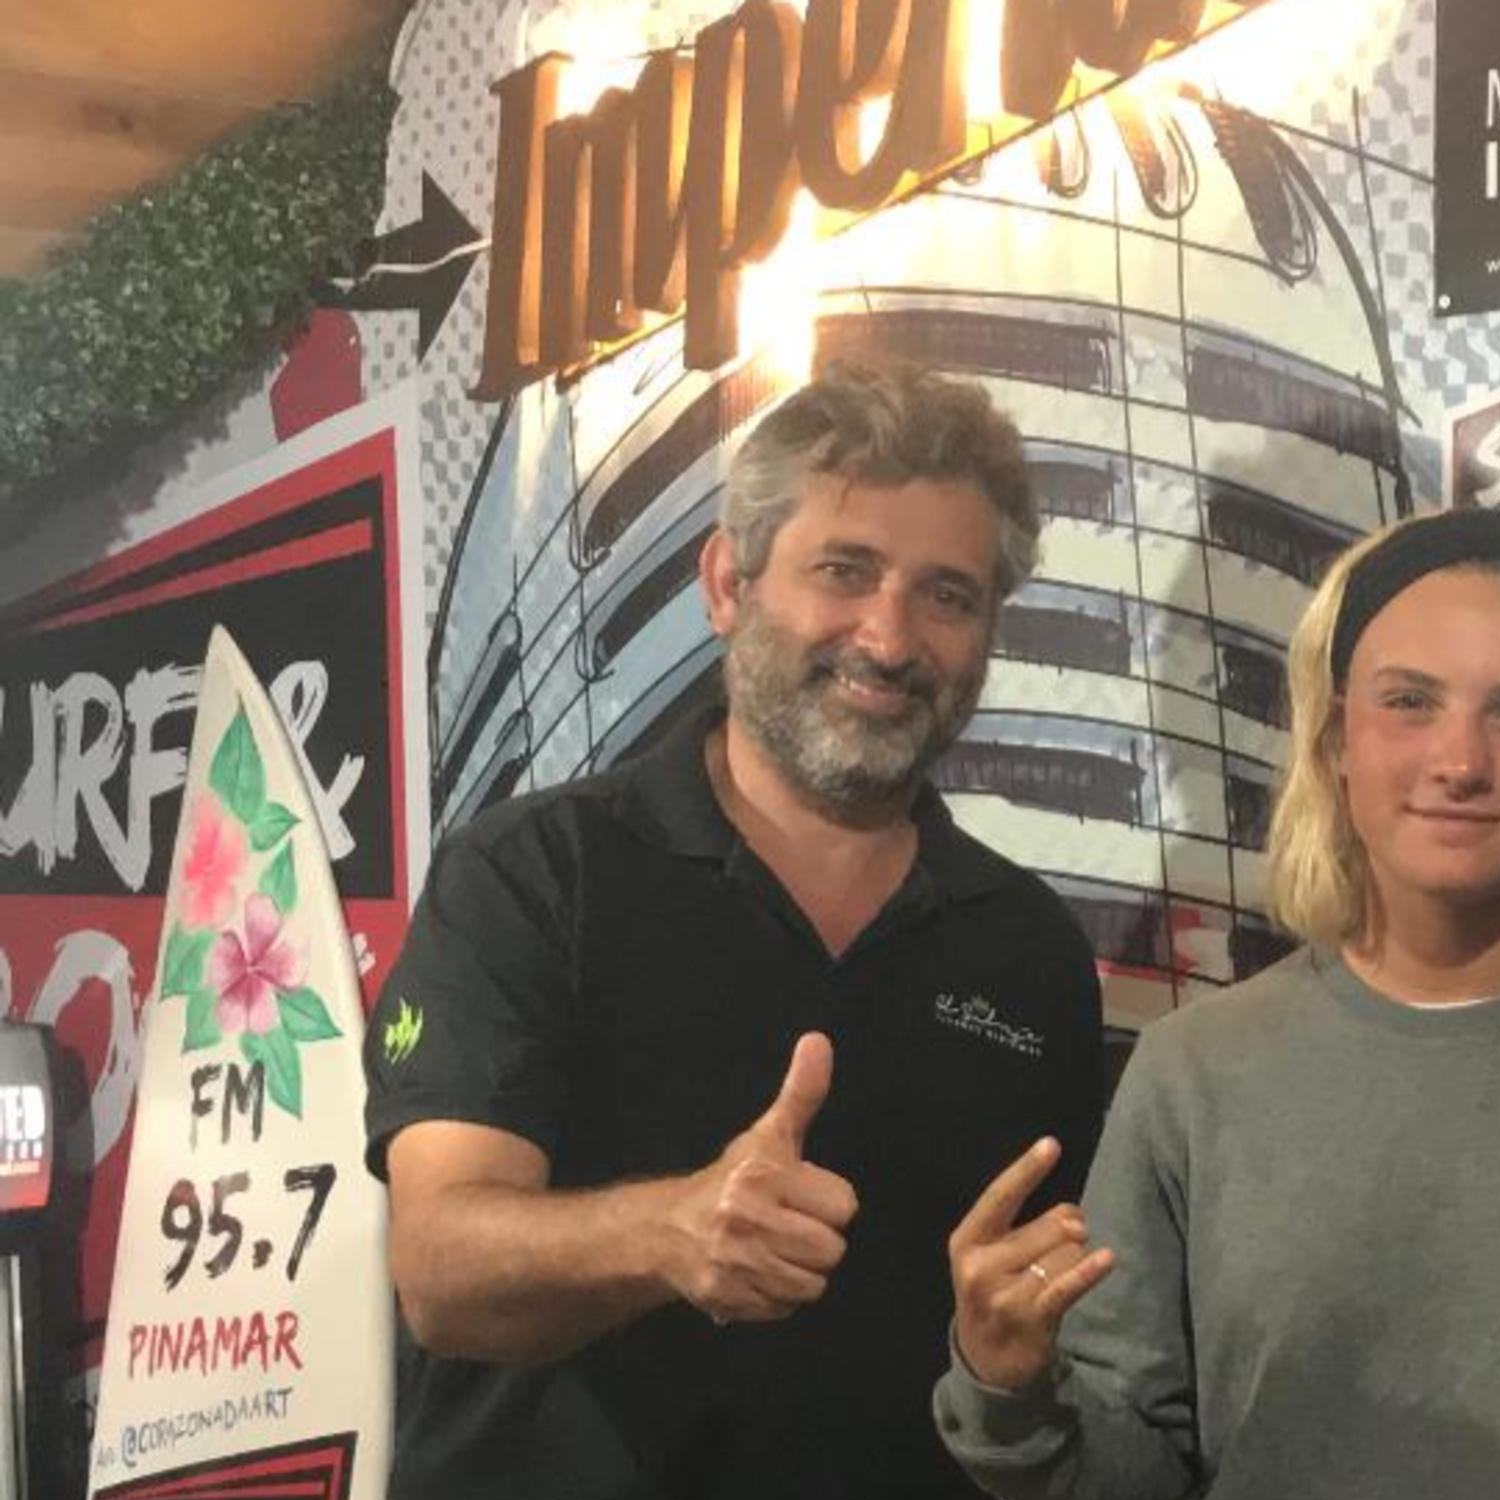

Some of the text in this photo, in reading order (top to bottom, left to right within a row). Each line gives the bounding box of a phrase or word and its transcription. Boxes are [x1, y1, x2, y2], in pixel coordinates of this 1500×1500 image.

[0, 660, 204, 892] URF
[189, 1059, 265, 1153] FM
[160, 1163, 337, 1293] 95.7
[128, 1310, 304, 1379] PINAMAR
